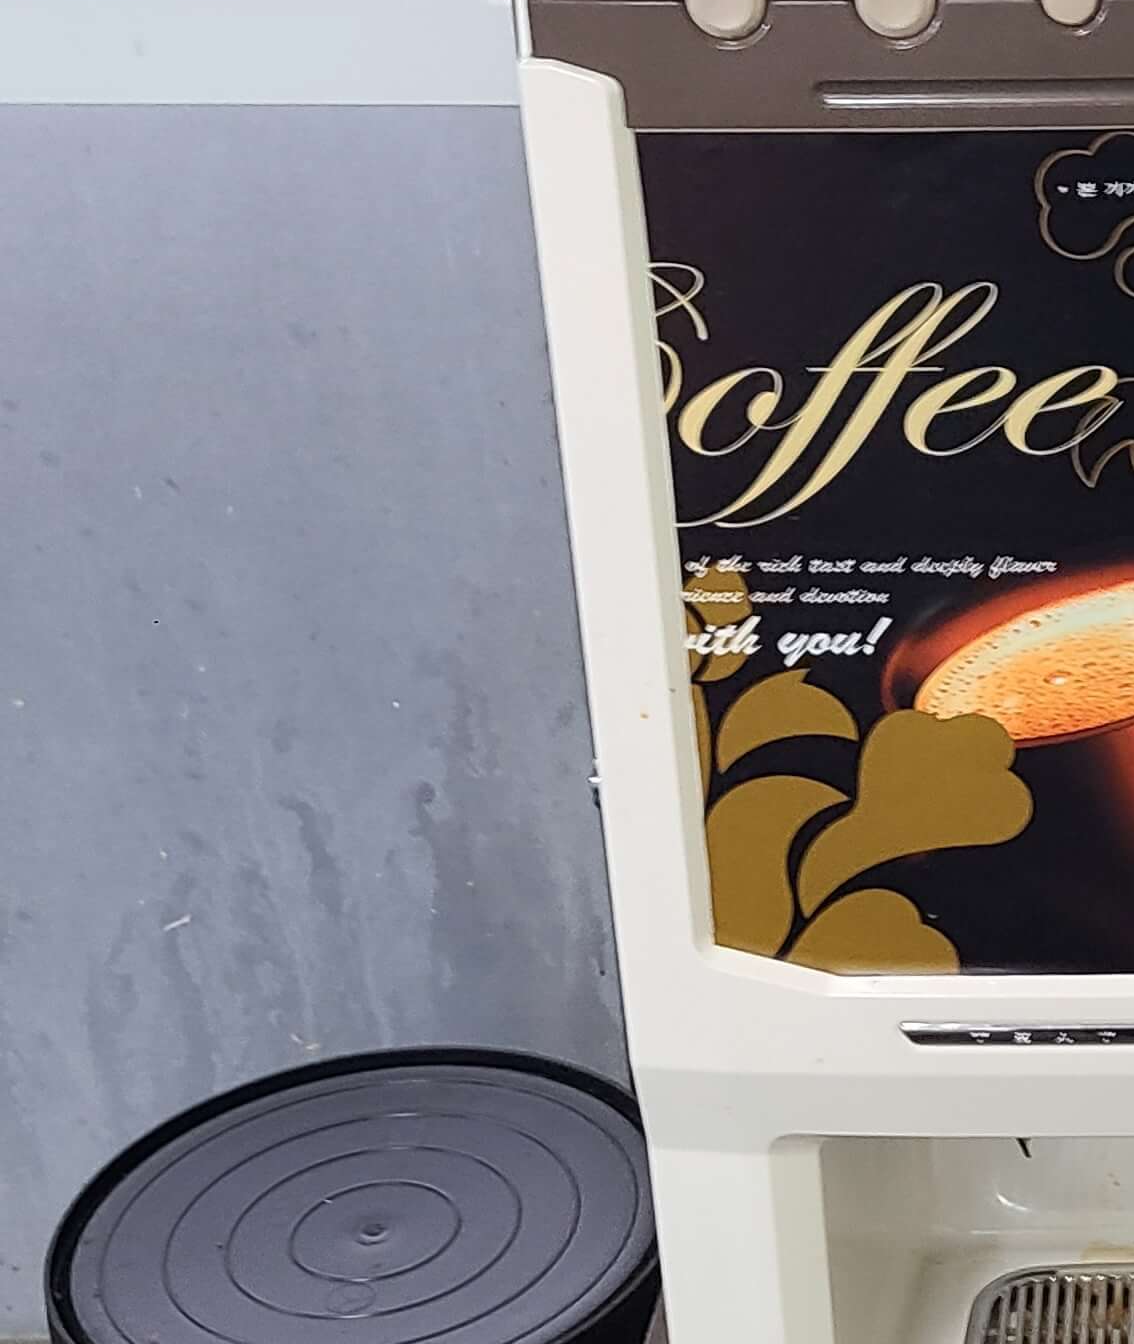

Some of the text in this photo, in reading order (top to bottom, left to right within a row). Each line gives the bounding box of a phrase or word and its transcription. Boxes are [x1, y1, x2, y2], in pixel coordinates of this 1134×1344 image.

[648, 262, 1124, 529] offee
[684, 555, 711, 578] of
[716, 555, 752, 572] the
[757, 555, 802, 572] rich
[859, 556, 908, 573] and
[748, 587, 796, 603] and
[800, 587, 889, 603] devotion
[777, 616, 893, 667] you!
